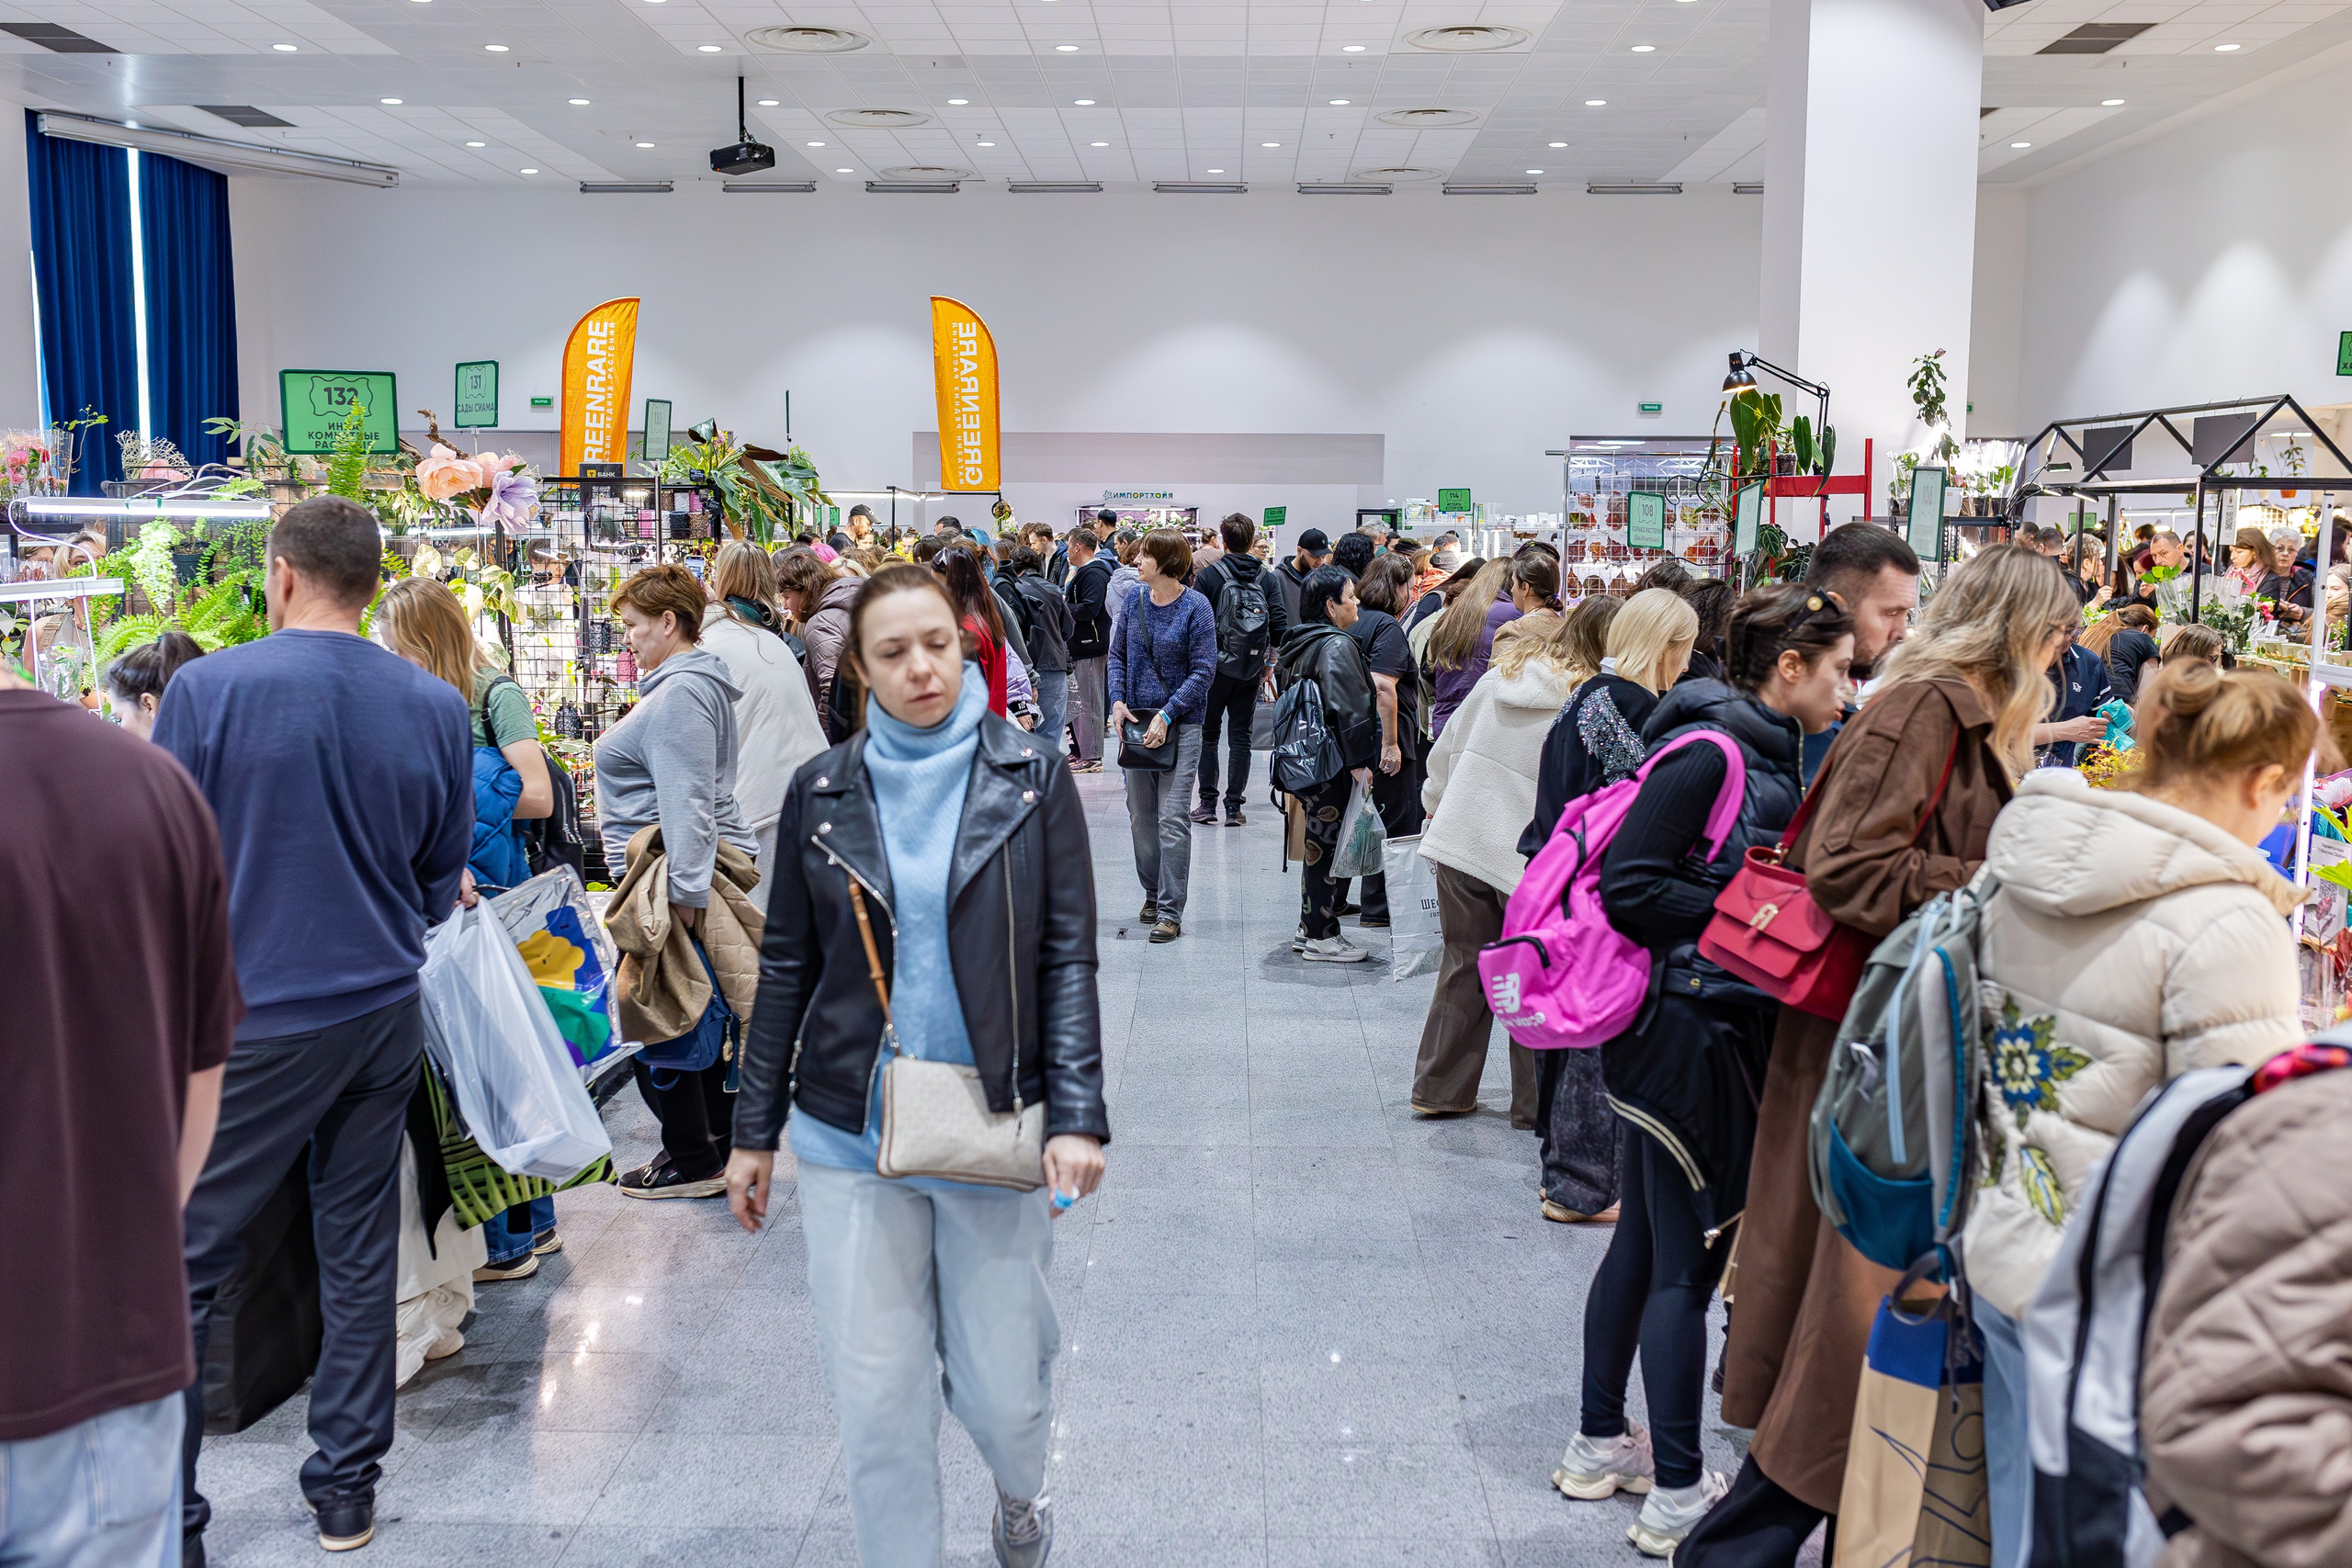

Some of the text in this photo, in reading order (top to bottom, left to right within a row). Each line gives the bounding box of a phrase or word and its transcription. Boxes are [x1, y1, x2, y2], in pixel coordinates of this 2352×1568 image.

[607, 321, 616, 379] РАСТЕНИЙ
[470, 375, 481, 389] 131
[323, 387, 358, 406] 132
[583, 320, 608, 462] REENRARE
[457, 402, 494, 414] САДЫ СИАМА
[605, 385, 614, 429] РЕДКИХ
[328, 423, 359, 431] ИНА
[308, 431, 380, 440] КОМНТЫЕ
[1113, 491, 1173, 499] ИМПОРТХОЙЯ
[1642, 503, 1654, 516] 108
